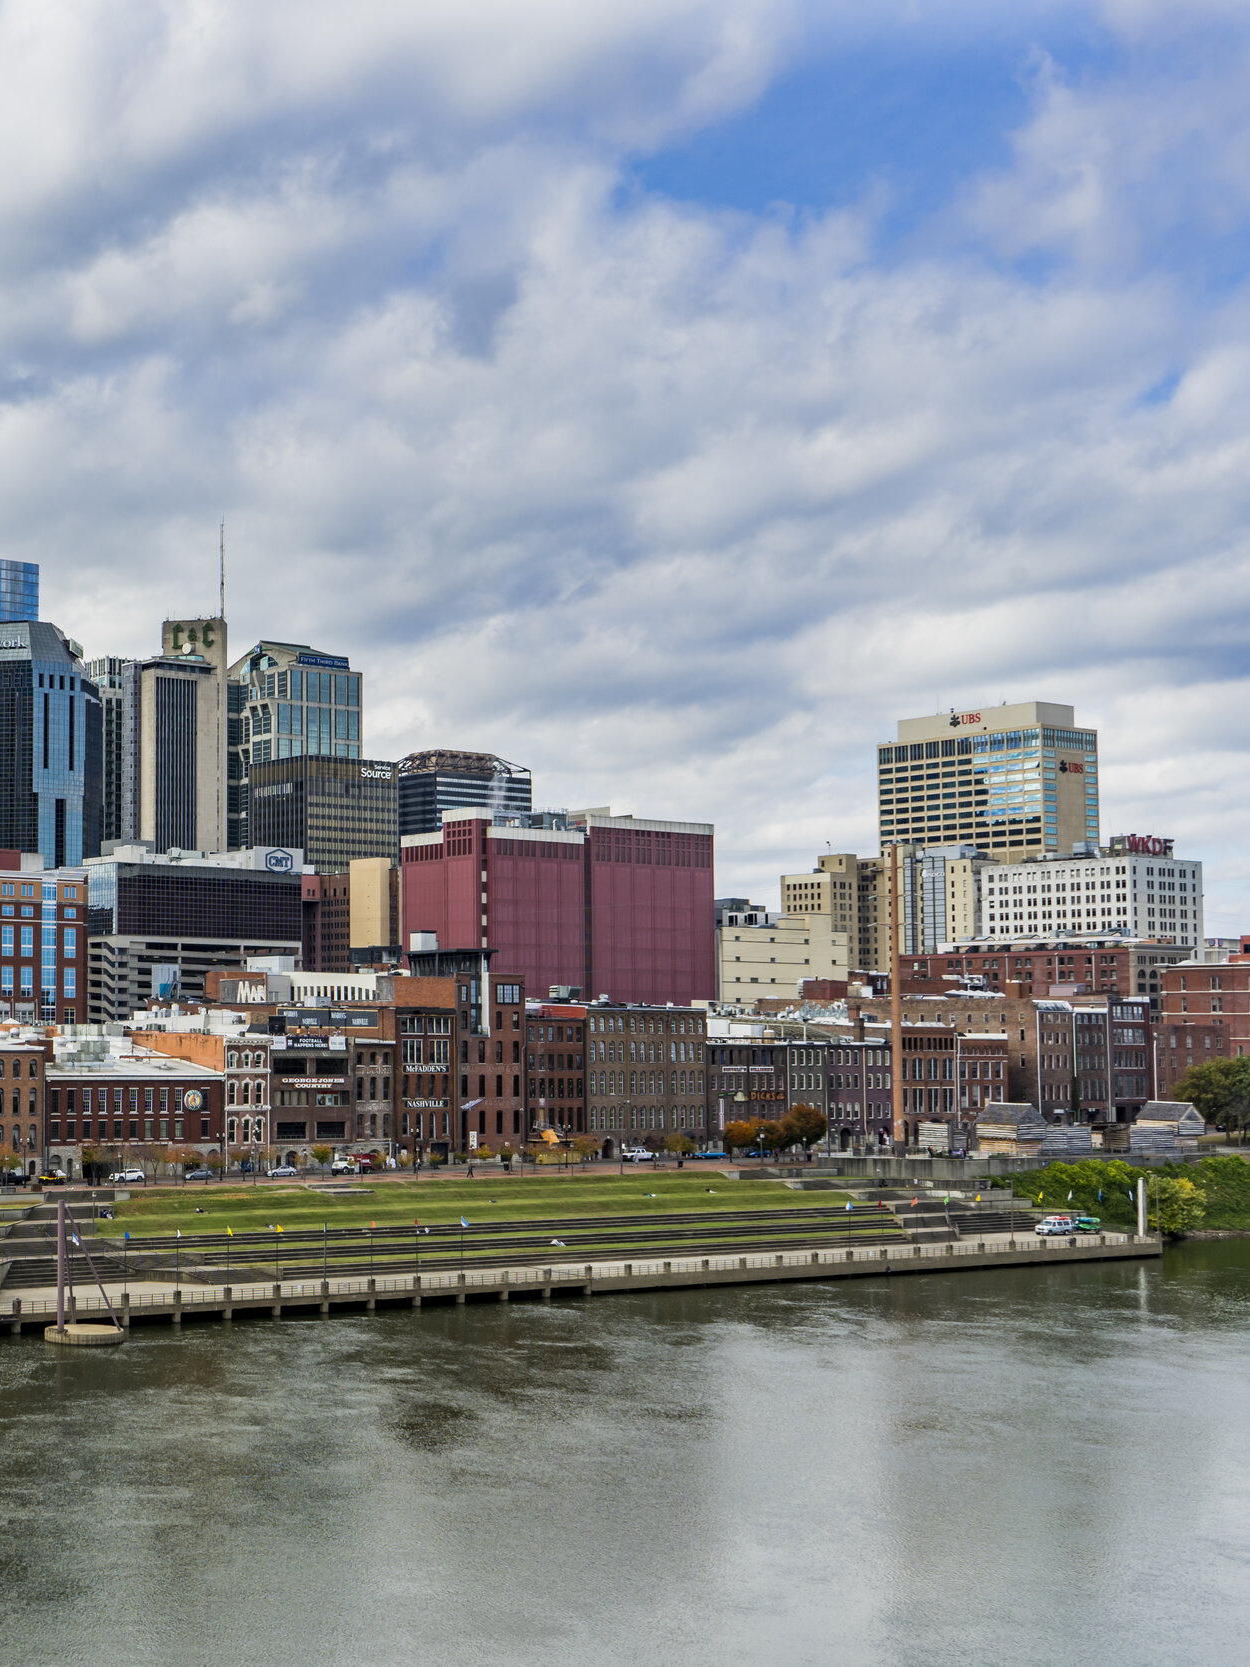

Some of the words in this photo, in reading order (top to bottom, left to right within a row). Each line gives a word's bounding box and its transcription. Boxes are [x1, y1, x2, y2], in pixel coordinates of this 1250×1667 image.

[961, 712, 981, 725] UBS
[361, 767, 392, 780] Source
[1068, 762, 1085, 775] UBS
[1126, 835, 1175, 856] WKDF
[268, 855, 291, 868] CMT
[406, 1064, 447, 1073] McFADDEN'S
[407, 1100, 445, 1108] NASHVILLE
